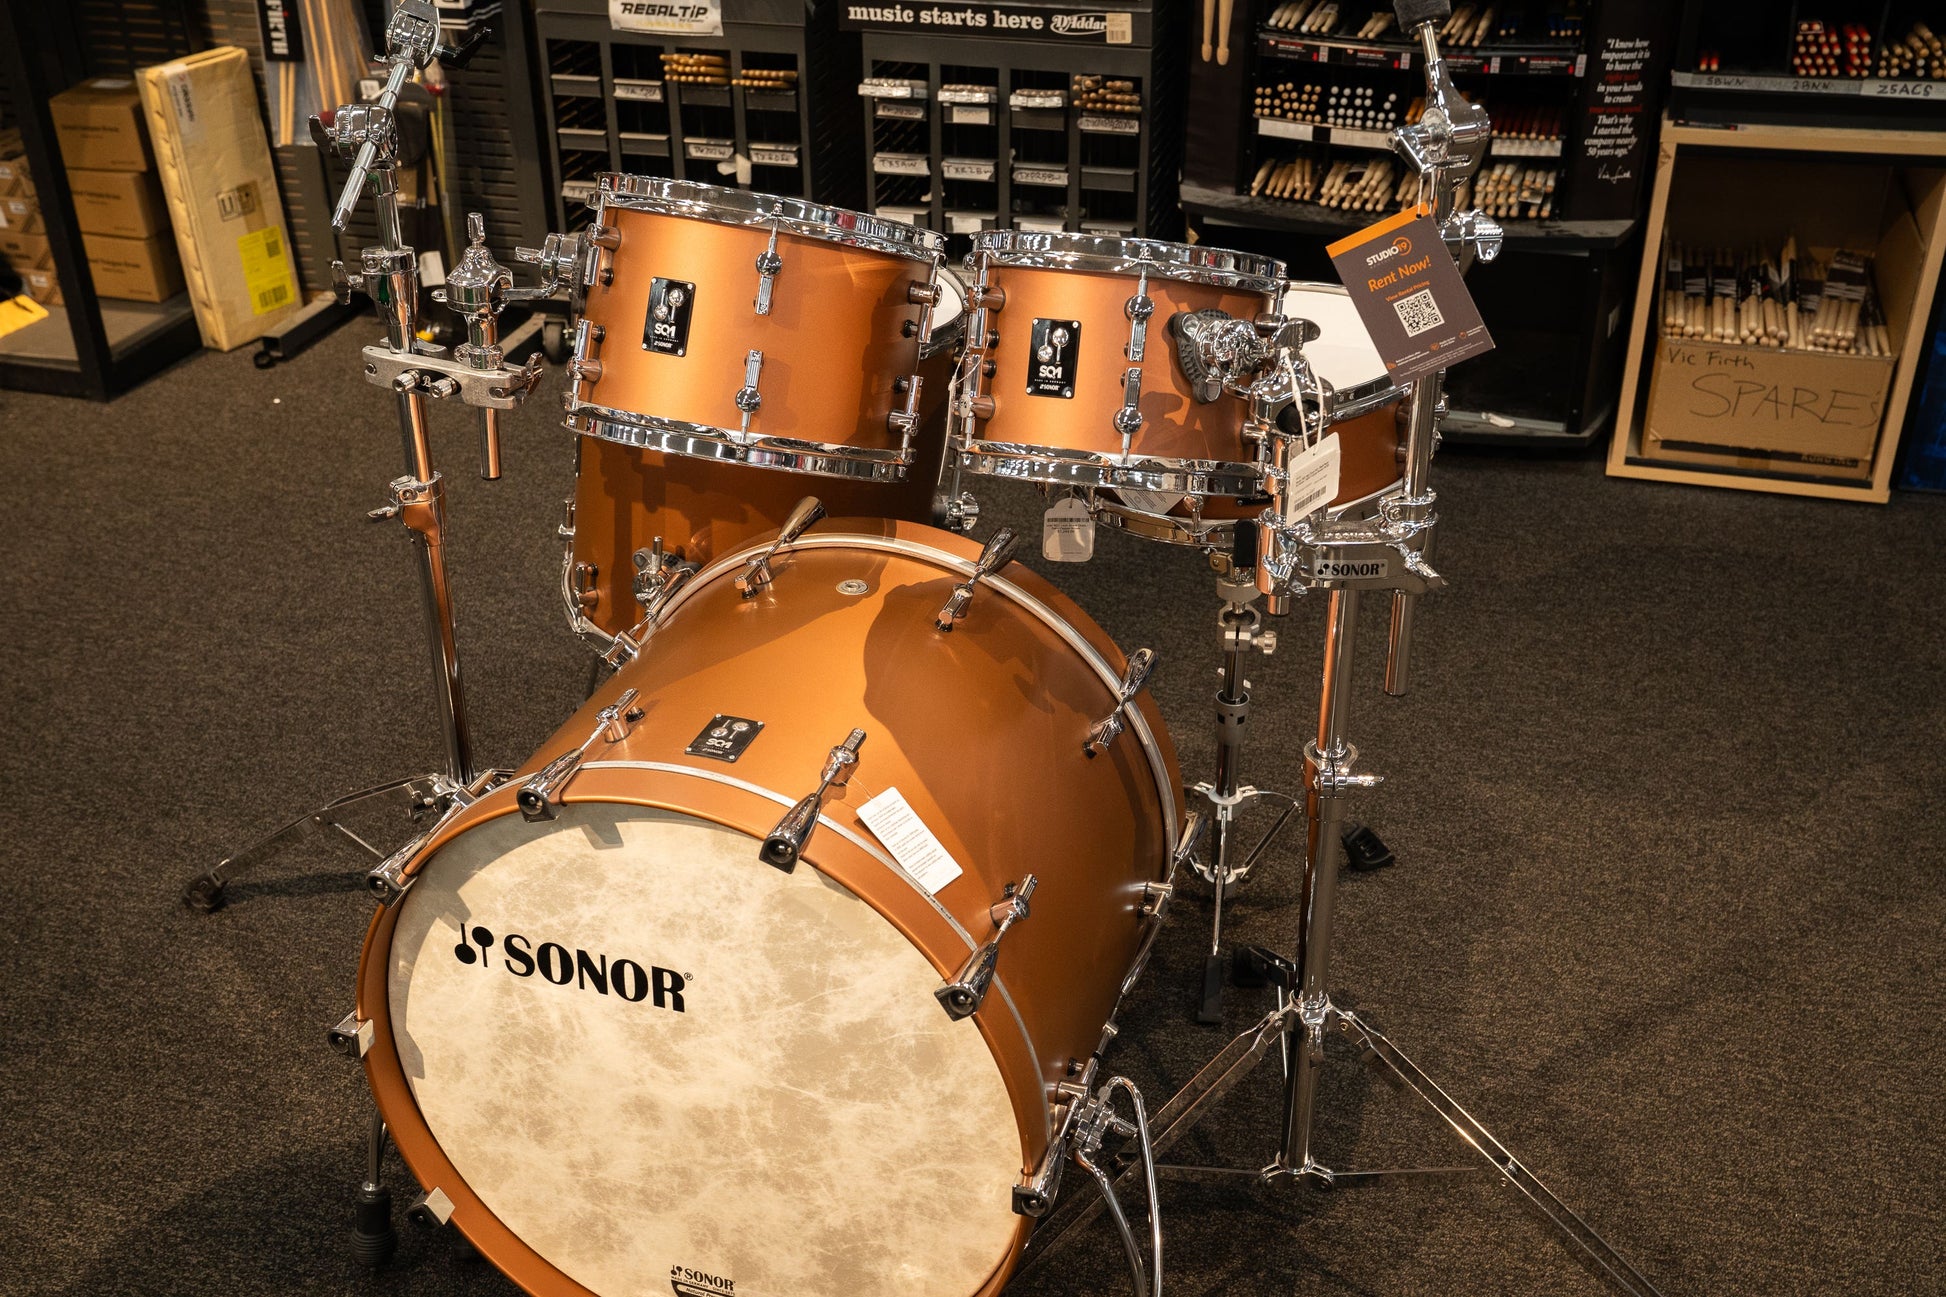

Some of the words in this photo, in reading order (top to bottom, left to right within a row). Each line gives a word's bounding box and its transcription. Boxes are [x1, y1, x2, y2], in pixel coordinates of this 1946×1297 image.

[848, 4, 914, 23] music
[920, 7, 987, 27] starts
[993, 10, 1044, 30] here
[1050, 14, 1107, 34] D'Addar
[1615, 39, 1634, 48] know
[1634, 38, 1650, 48] how
[1601, 49, 1638, 62] important
[1605, 62, 1614, 71] to
[1614, 61, 1631, 71] have
[1631, 60, 1643, 70] the
[1605, 85, 1622, 95] your
[1622, 81, 1643, 92] hands
[1604, 95, 1612, 103] to
[1612, 95, 1634, 103] create
[1619, 114, 1634, 125] why
[1597, 125, 1622, 135] started
[1622, 125, 1633, 134] the
[1584, 138, 1615, 148] company
[1616, 134, 1638, 146] nearly
[1596, 148, 1614, 158] years
[1367, 271, 1397, 293] Rent
[1399, 255, 1432, 279] Now!
[654, 322, 676, 339] SQ1
[1669, 347, 1696, 366] Vic
[1706, 350, 1755, 370] Firth
[1039, 364, 1063, 380] SQ1
[1331, 563, 1380, 576] SONOR
[705, 738, 733, 749] SQ1
[503, 933, 685, 1013] SONOR
[684, 1268, 734, 1291] SONOR
